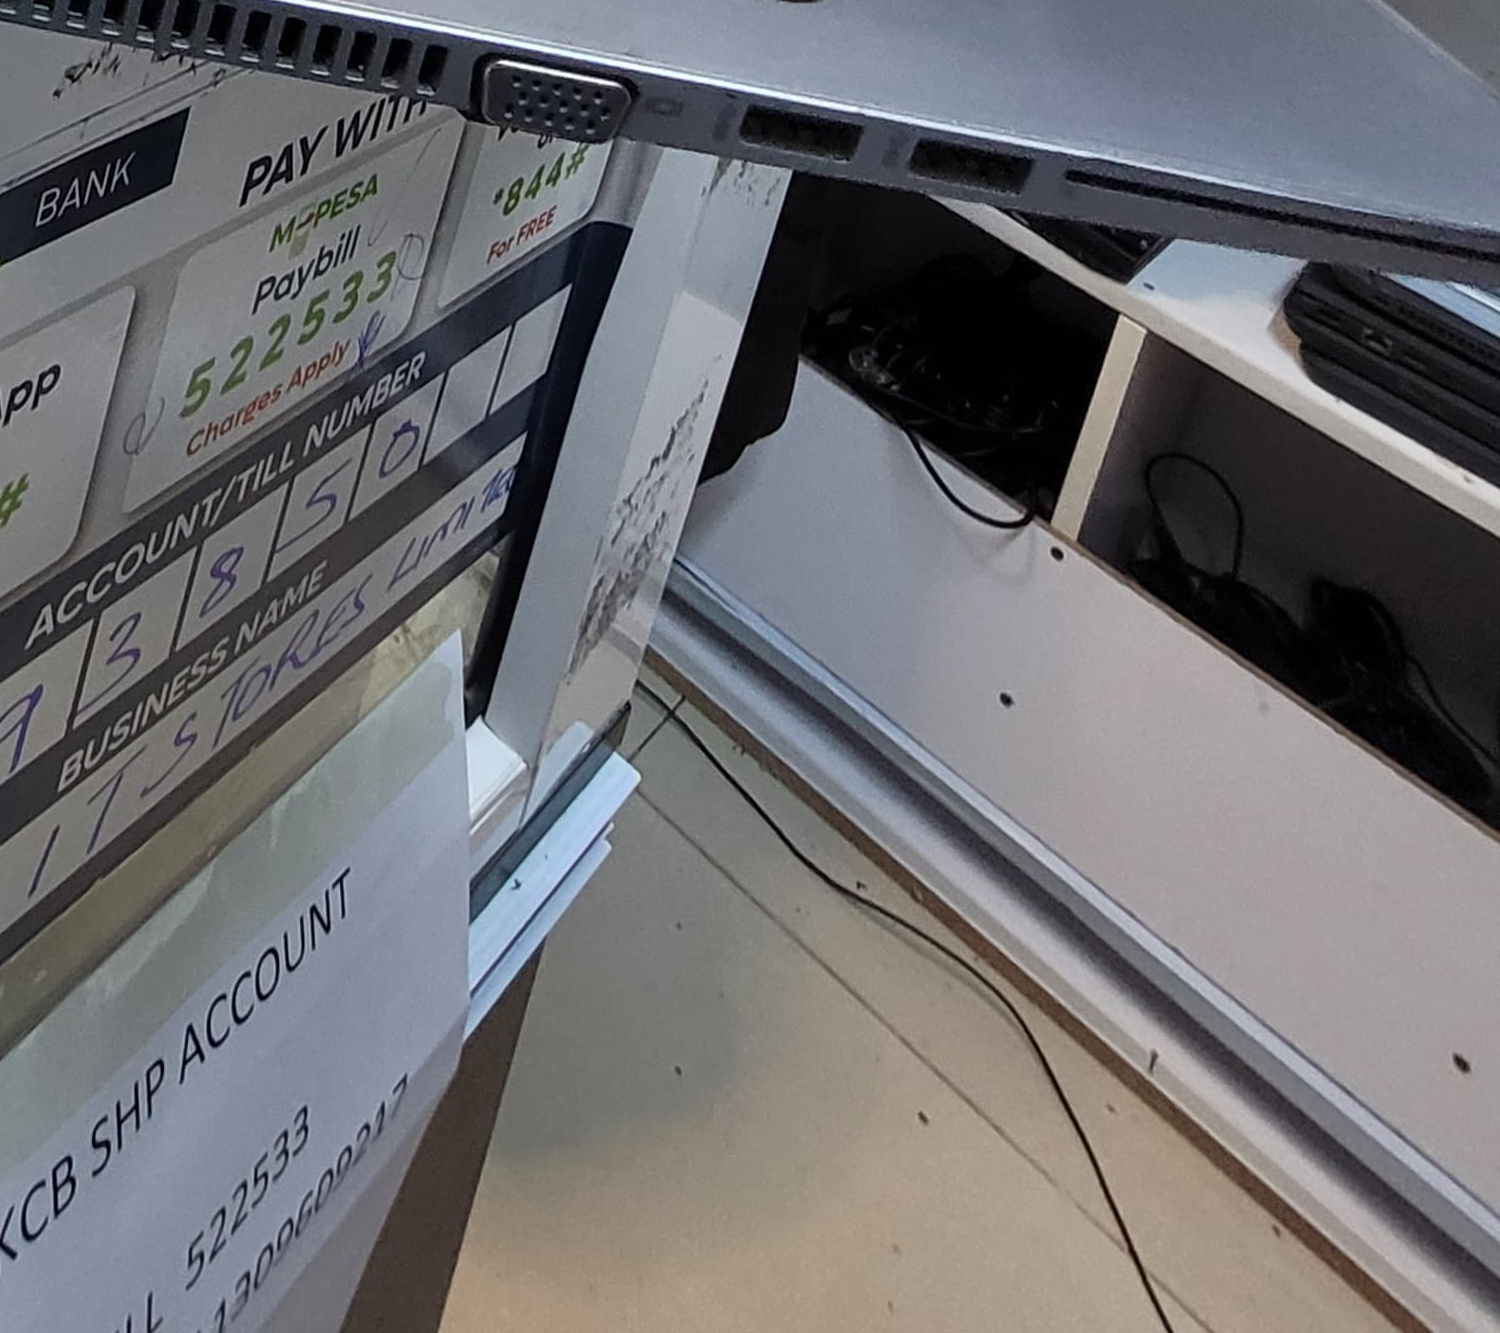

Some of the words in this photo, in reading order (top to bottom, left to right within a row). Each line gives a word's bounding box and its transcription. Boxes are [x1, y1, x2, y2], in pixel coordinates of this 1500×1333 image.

[34, 151, 137, 229] BANK
[238, 126, 329, 208] PAY
[252, 224, 362, 316] Paybill
[487, 233, 516, 264] For
[518, 205, 557, 247] FREE
[179, 250, 397, 419] 522533
[186, 386, 282, 457] Charges
[287, 339, 351, 388] Apply
[24, 440, 295, 650] ACCOUNT/TILL
[303, 351, 427, 458] NUMBER
[200, 546, 244, 618] 8
[58, 636, 228, 793] BUSINESS
[234, 560, 329, 651] NAME
[91, 1059, 166, 1179] SHP
[179, 867, 352, 1085] ACCOUNT
[186, 1104, 310, 1291] 522533
